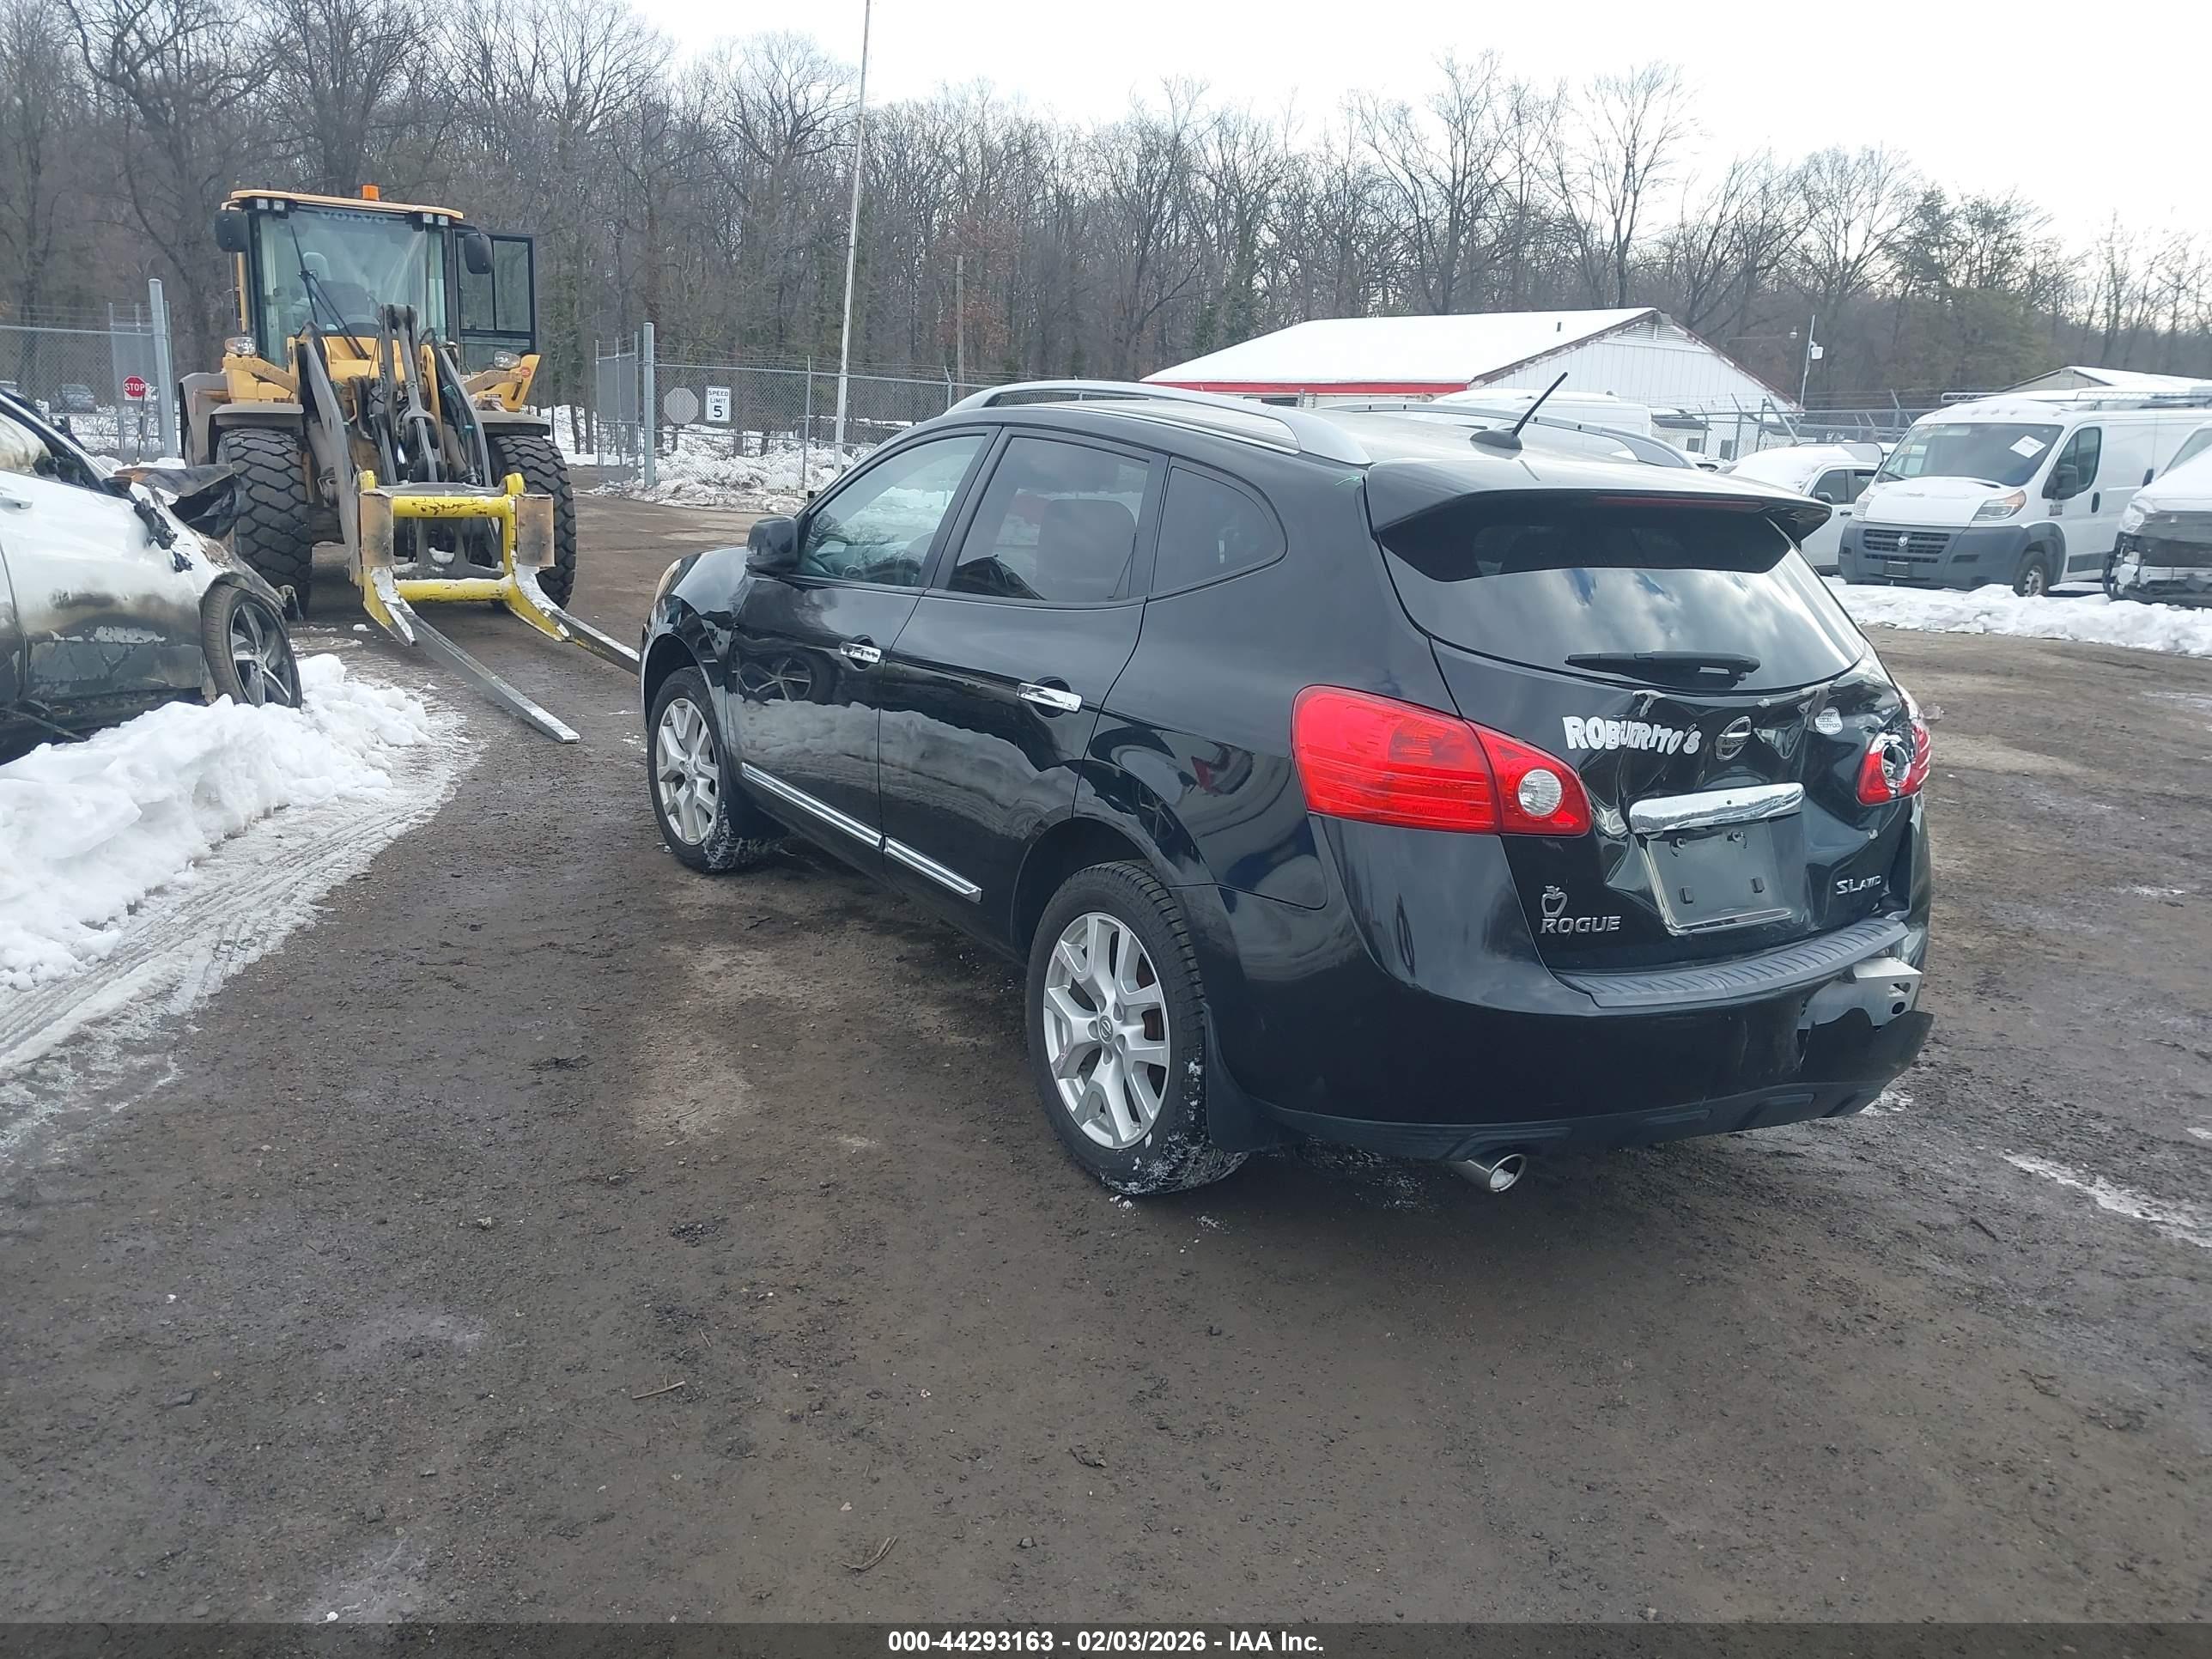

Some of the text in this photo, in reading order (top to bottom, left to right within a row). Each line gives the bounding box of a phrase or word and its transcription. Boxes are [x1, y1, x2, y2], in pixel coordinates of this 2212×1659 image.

[125, 383, 145, 392] STOP
[714, 405, 723, 418] 5
[1540, 916, 1622, 934] ROGUE
